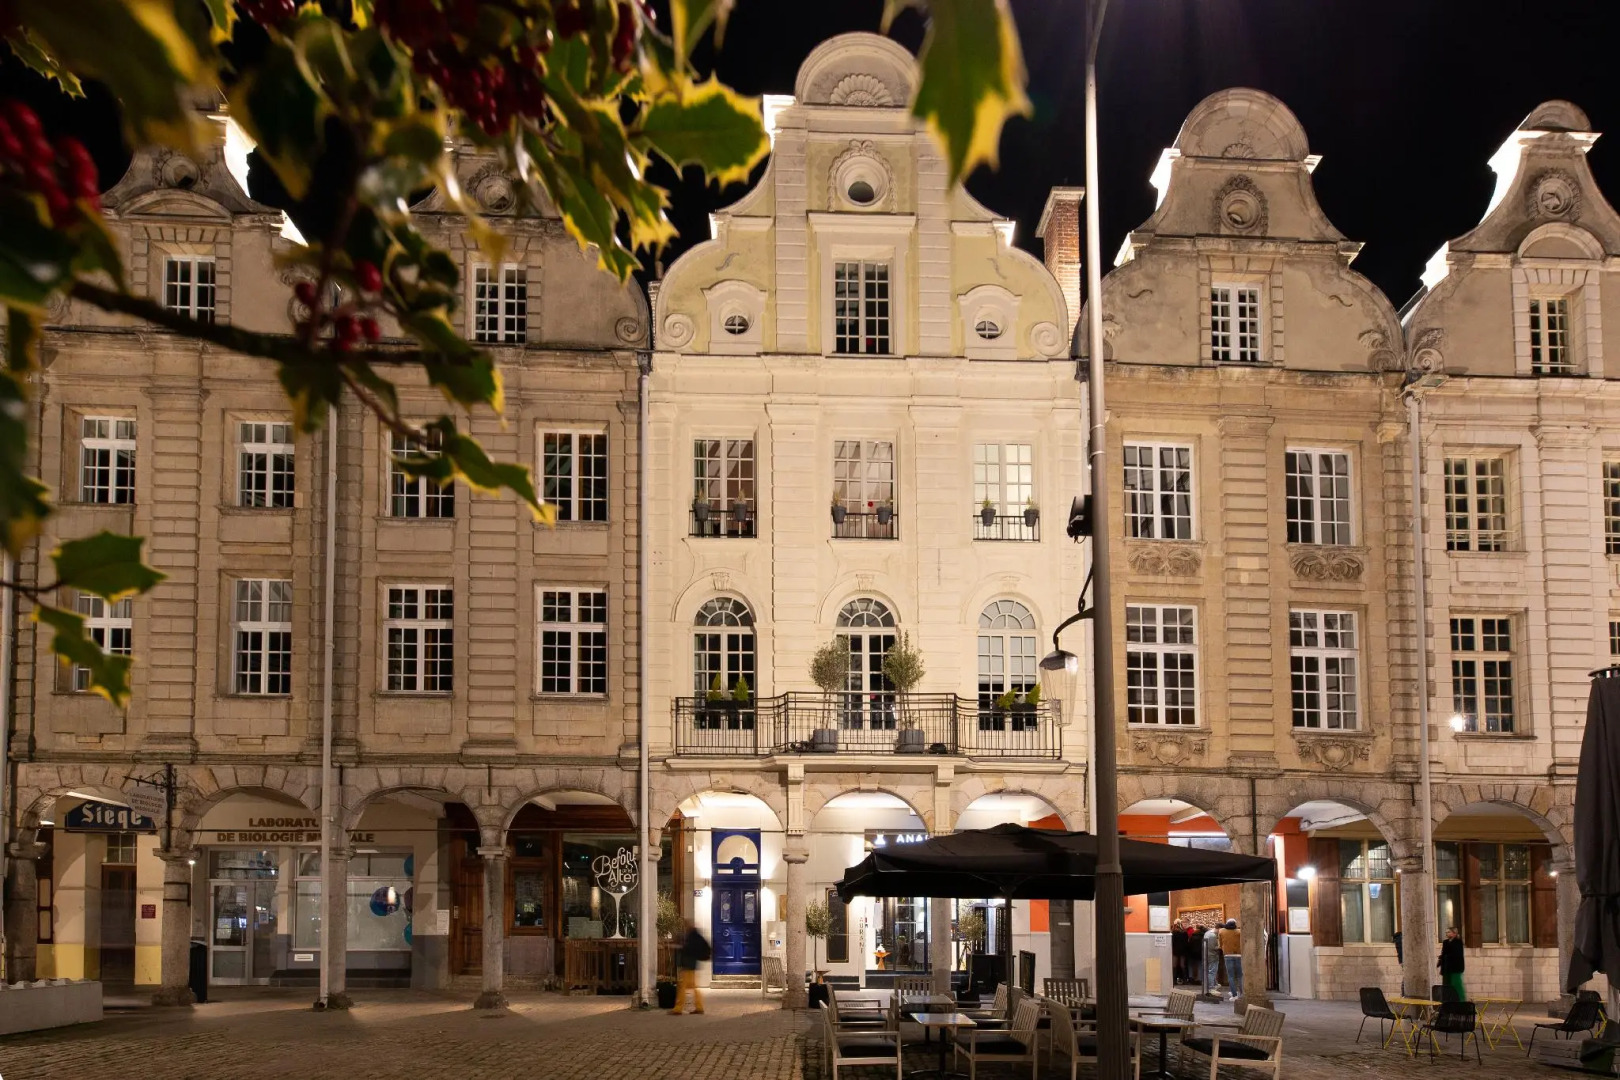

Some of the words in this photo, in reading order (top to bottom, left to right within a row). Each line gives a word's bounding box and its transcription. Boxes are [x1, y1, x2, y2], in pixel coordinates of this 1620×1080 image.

[217, 832, 235, 843] DE
[238, 832, 303, 843] BIOLOGIE
[306, 832, 374, 843] MALE
